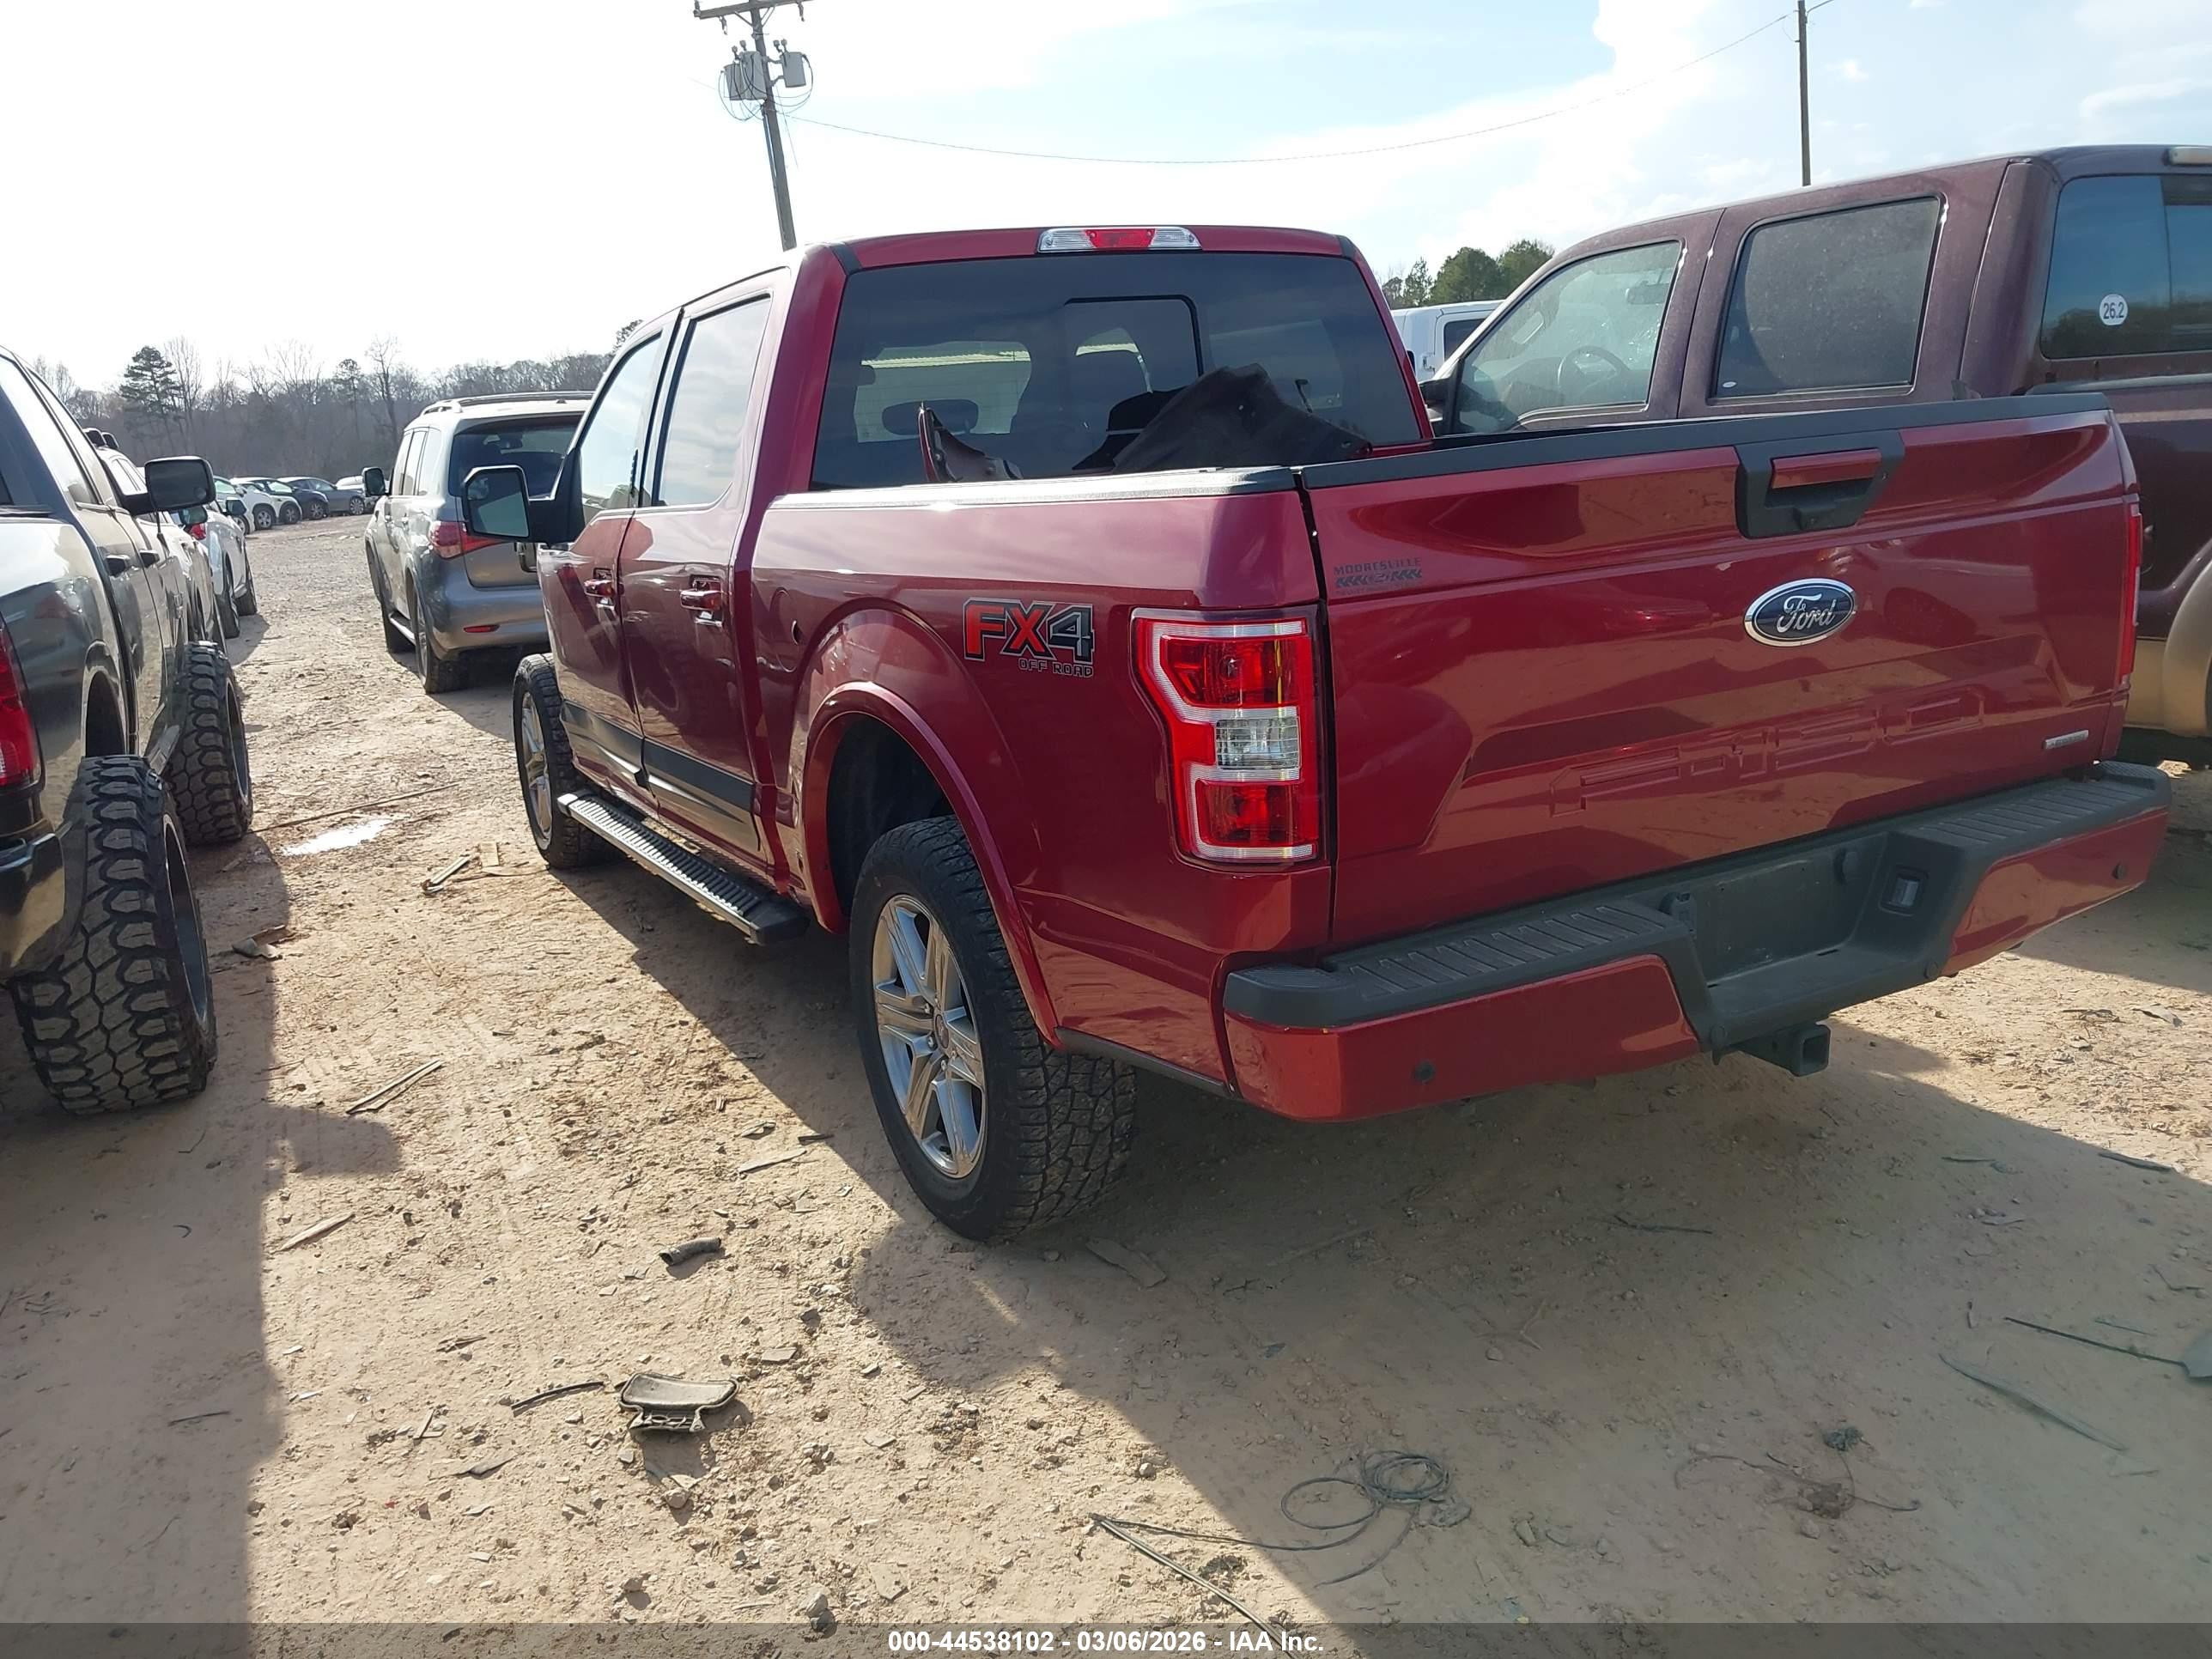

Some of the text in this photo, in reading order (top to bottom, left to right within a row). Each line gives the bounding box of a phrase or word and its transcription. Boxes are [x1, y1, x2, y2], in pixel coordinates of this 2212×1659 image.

[2103, 301, 2124, 319] 26.2
[1333, 556, 1422, 575] MOORESVILLE
[1776, 593, 1837, 633] Ford
[963, 597, 1095, 665] FX4
[1018, 658, 1094, 678] OFF ROAD
